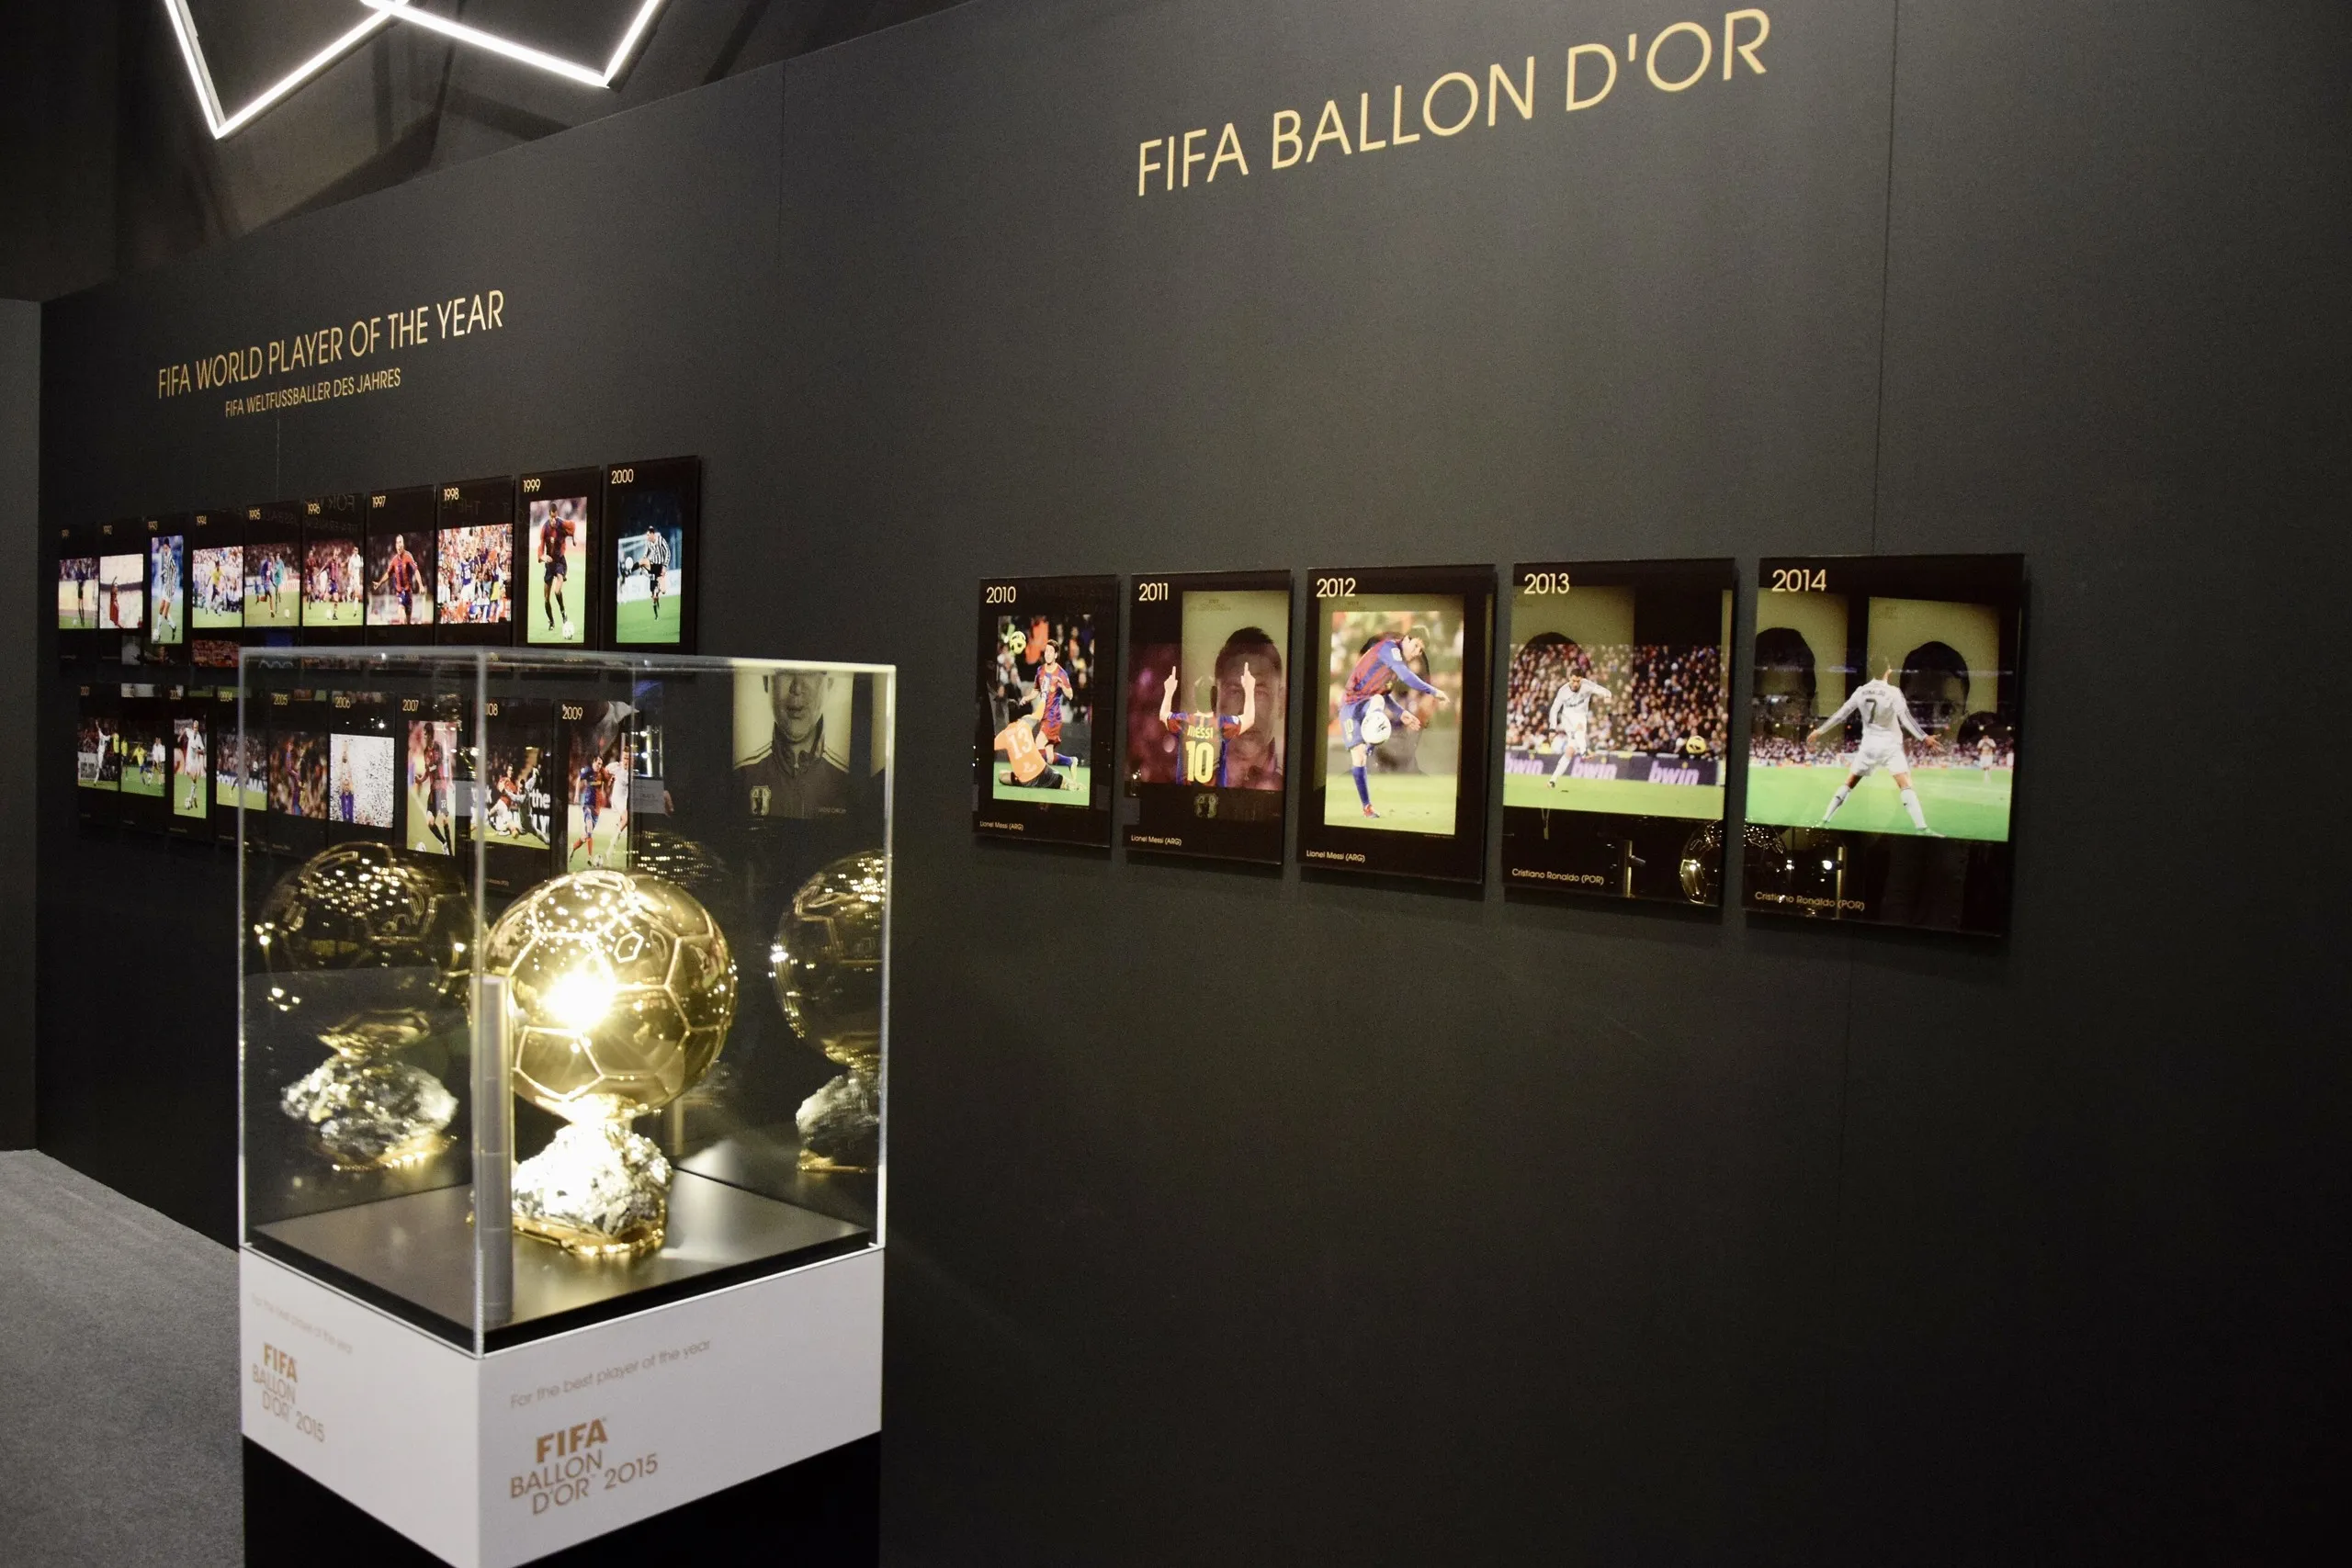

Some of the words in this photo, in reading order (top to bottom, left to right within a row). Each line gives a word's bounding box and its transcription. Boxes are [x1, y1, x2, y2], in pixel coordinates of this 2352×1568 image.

[1137, 122, 1250, 197] FIFA
[1271, 55, 1535, 170] BALLON
[1566, 7, 1770, 111] D'OR
[158, 363, 191, 400] FIFA
[196, 345, 263, 391] WORLD
[268, 326, 344, 375] PLAYER
[349, 317, 381, 357] OF
[388, 306, 429, 350] THE
[436, 289, 504, 340] YEAR
[225, 398, 244, 418] FIFA
[246, 376, 331, 413] WELTFUSSBALLER
[334, 377, 355, 398] DES
[356, 367, 401, 394] JAHRES
[523, 478, 541, 493] 1999
[611, 468, 634, 485] 2000
[372, 495, 387, 509] 1997
[444, 487, 459, 502] 1998
[248, 508, 261, 521] 1995
[307, 502, 321, 515] 1996
[1316, 577, 1357, 598] 2012
[1524, 573, 1570, 595] 2013
[1771, 569, 1826, 592] 2014
[986, 586, 1016, 604] 2010
[1138, 582, 1169, 602] 2011
[274, 694, 288, 706] 2005
[334, 696, 351, 709] 2006
[402, 699, 419, 712] 2007
[562, 705, 583, 720] 2009
[1866, 698, 1877, 724] 7
[1187, 725, 1213, 739] MESSI
[1006, 727, 1033, 760] 13
[1185, 740, 1214, 784] 10
[1570, 756, 1617, 780] bwin
[1648, 760, 1700, 785] bwin
[1130, 834, 1148, 842] Lionel
[1165, 837, 1182, 846] (ARG)
[1306, 850, 1326, 859] Lionel
[1327, 852, 1344, 860] Messi
[1345, 852, 1366, 863] (ARG)
[1511, 868, 1545, 880] Cristiano
[1546, 871, 1579, 883] Ronaldo
[1581, 874, 1604, 886] (POR)
[1796, 895, 1835, 908] Ronaldo
[1838, 897, 1865, 911] (POR)
[264, 1342, 298, 1383] FIFA
[252, 1362, 296, 1404] BALLON
[510, 1393, 533, 1409] For
[537, 1383, 560, 1402] the
[563, 1372, 594, 1393] best
[597, 1359, 639, 1385] player
[642, 1354, 656, 1370] of
[659, 1348, 680, 1365] the
[683, 1340, 711, 1359] year
[295, 1410, 326, 1443] 2015
[536, 1417, 608, 1464] FIFA
[511, 1449, 604, 1499] BALLON
[532, 1477, 590, 1516] D'OR
[604, 1452, 659, 1491] 2015
